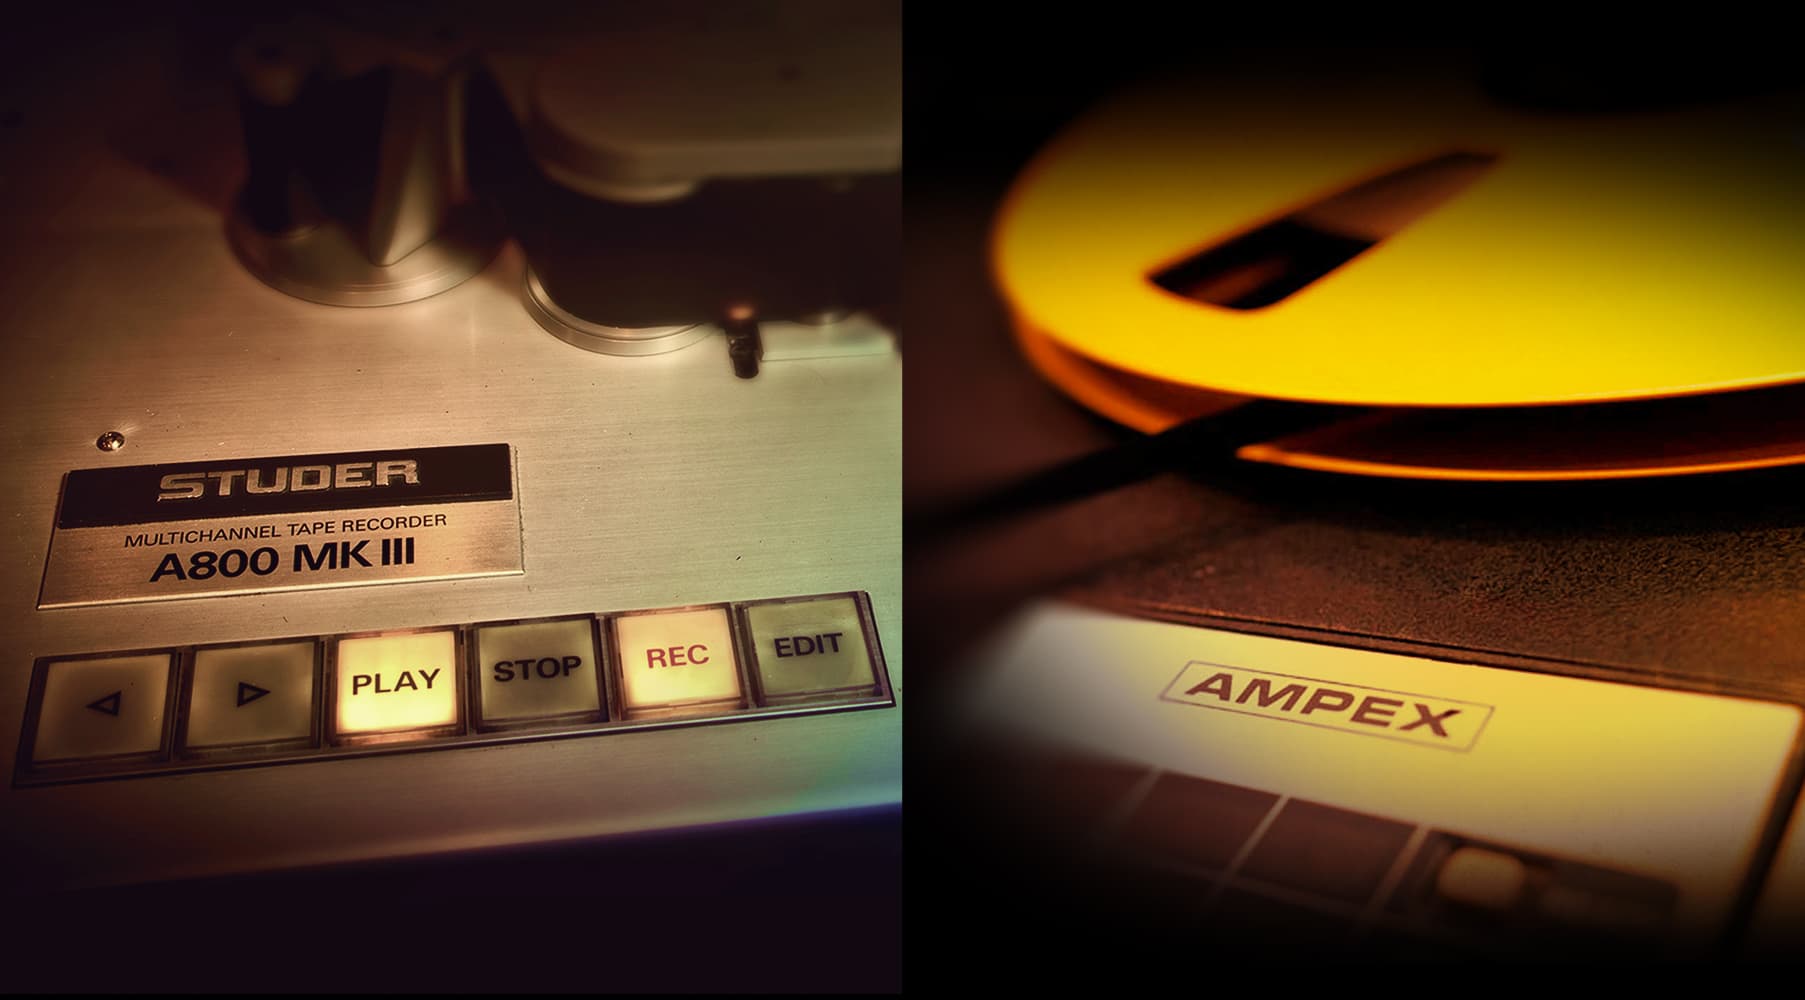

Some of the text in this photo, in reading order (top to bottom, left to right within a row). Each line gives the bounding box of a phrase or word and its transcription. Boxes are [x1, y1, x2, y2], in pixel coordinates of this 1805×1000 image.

[157, 458, 420, 502] STUDER
[124, 513, 447, 548] MULTICHANNEL TAPE RECORDER
[149, 537, 416, 583] A800 MK III
[646, 643, 710, 669] REC
[774, 631, 844, 659] EDIT
[352, 668, 441, 696] PLAY
[493, 655, 583, 683] STOP
[1184, 672, 1463, 738] AMPEX
